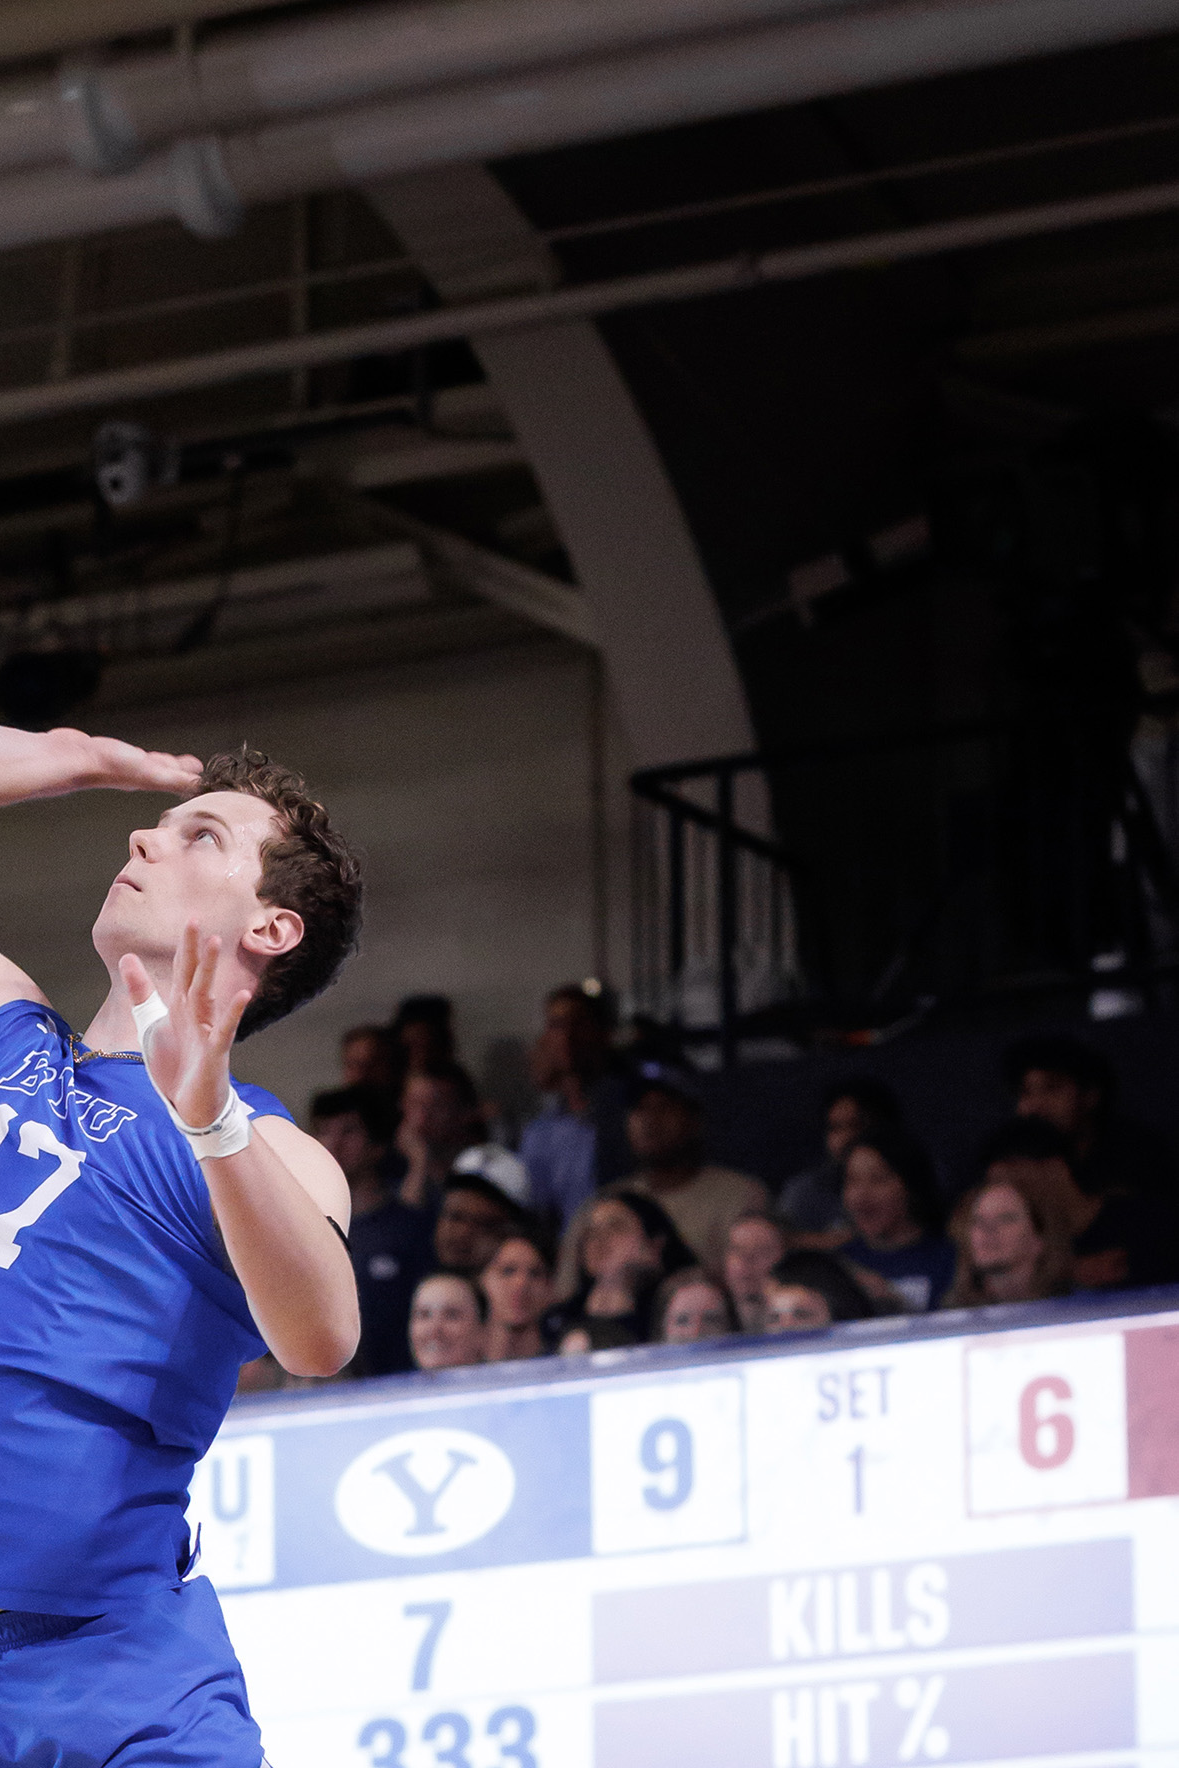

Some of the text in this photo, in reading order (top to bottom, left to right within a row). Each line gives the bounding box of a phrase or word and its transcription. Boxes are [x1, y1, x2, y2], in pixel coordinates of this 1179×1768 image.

[817, 1366, 892, 1424] SET
[1019, 1374, 1075, 1470] 6
[372, 1447, 479, 1538] Y
[640, 1416, 694, 1511] 9
[848, 1443, 865, 1515] 1
[403, 1562, 950, 1692] 7 KILLS
[897, 1676, 950, 1760] %
